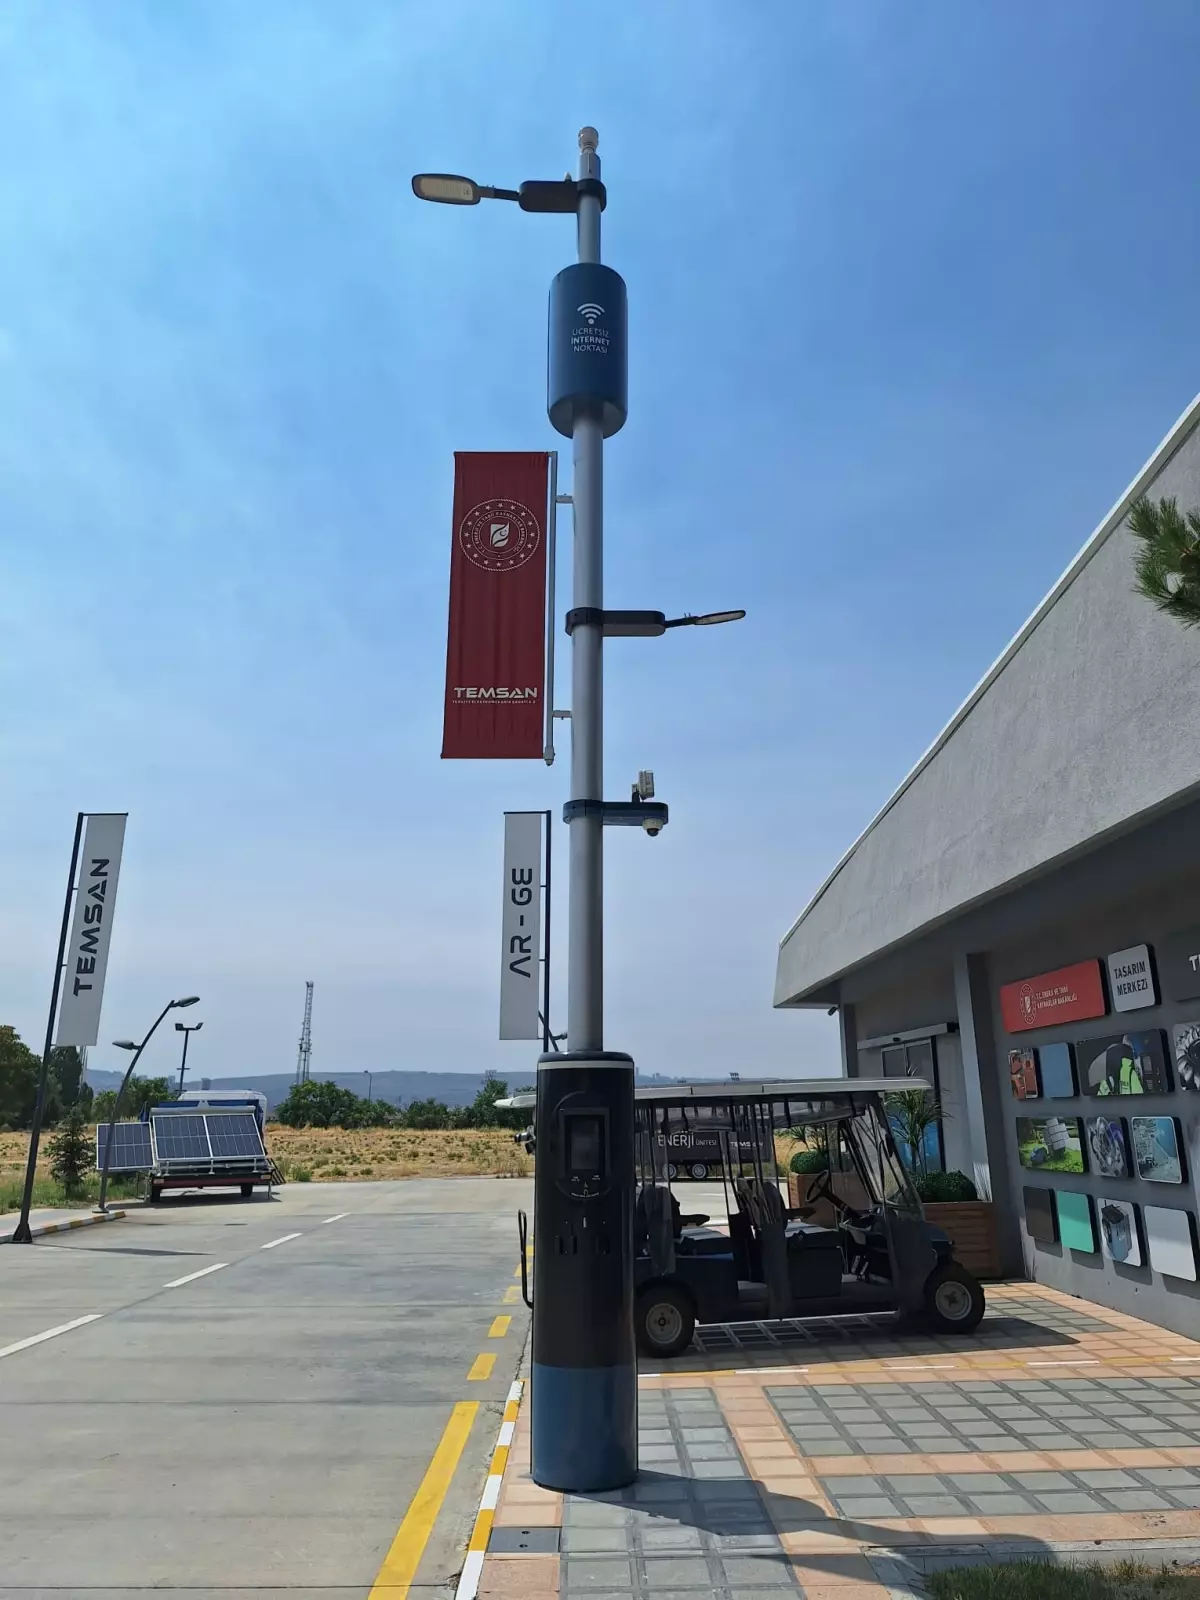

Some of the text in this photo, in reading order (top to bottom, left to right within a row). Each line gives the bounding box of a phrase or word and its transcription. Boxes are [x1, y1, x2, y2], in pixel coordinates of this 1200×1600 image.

[573, 344, 607, 354] NOKTASI
[453, 687, 537, 698] TEMSAN
[73, 858, 110, 997] TEMSAN
[1114, 961, 1146, 979] TASARIM
[1117, 977, 1149, 996] MERKEZİ
